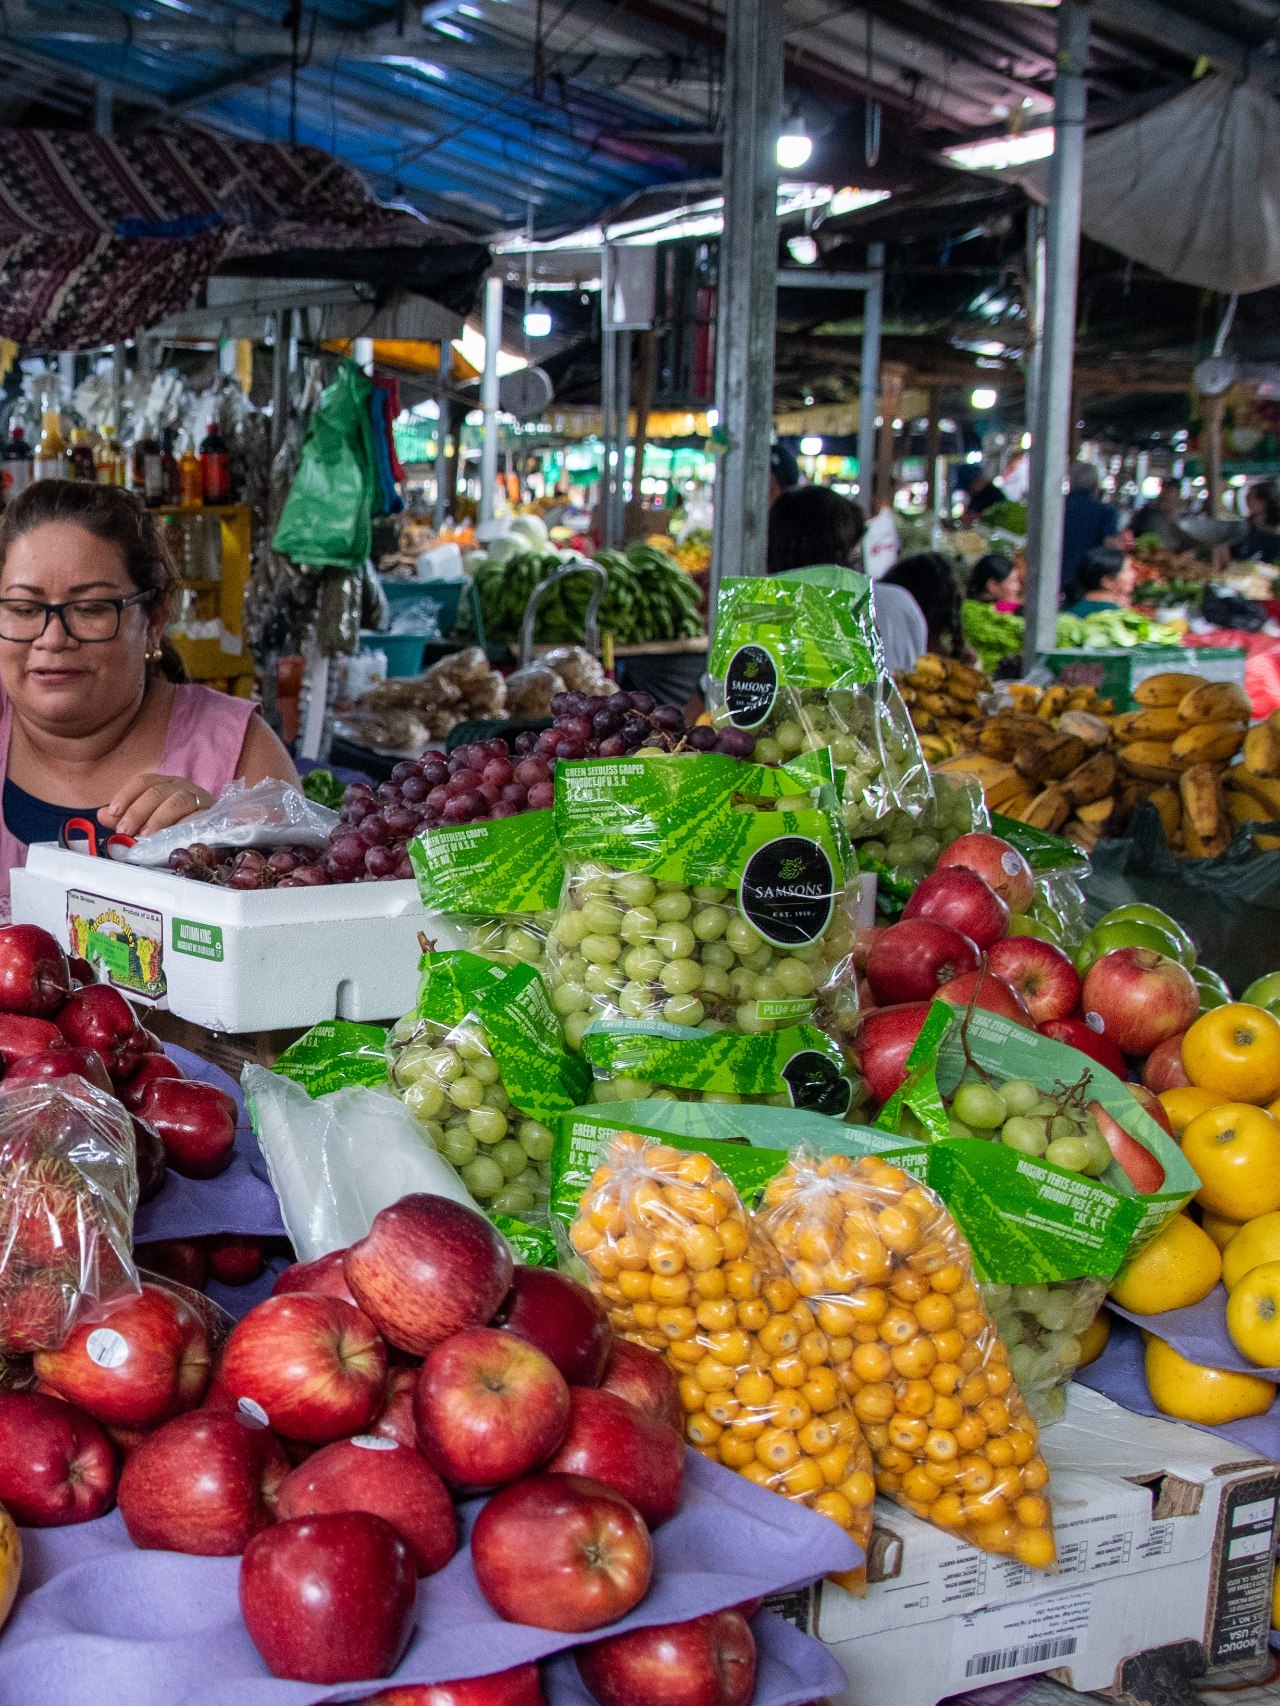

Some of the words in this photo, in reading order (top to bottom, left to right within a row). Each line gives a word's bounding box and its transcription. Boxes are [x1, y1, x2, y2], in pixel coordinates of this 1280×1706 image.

[732, 680, 771, 692] SAMSONS
[565, 767, 586, 777] GREEN
[588, 764, 618, 776] SEEDLESS
[619, 764, 644, 775] GRAPES
[440, 831, 467, 843] SEEDLESS
[466, 828, 489, 839] GRAPES
[755, 884, 823, 899] SAMSONS
[180, 924, 199, 942] AUTUMN
[200, 928, 212, 944] KING
[764, 1004, 788, 1015] PLU#
[573, 1123, 597, 1140] GREEN
[1016, 1160, 1048, 1181] RAISINS
[1047, 1172, 1071, 1190] VERTS
[1069, 1181, 1092, 1198] SANS
[1089, 1188, 1119, 1208] PÉPINS
[1037, 1184, 1073, 1206] PRODUIT
[1070, 1196, 1087, 1211] DES
[1229, 1628, 1249, 1641] USA
